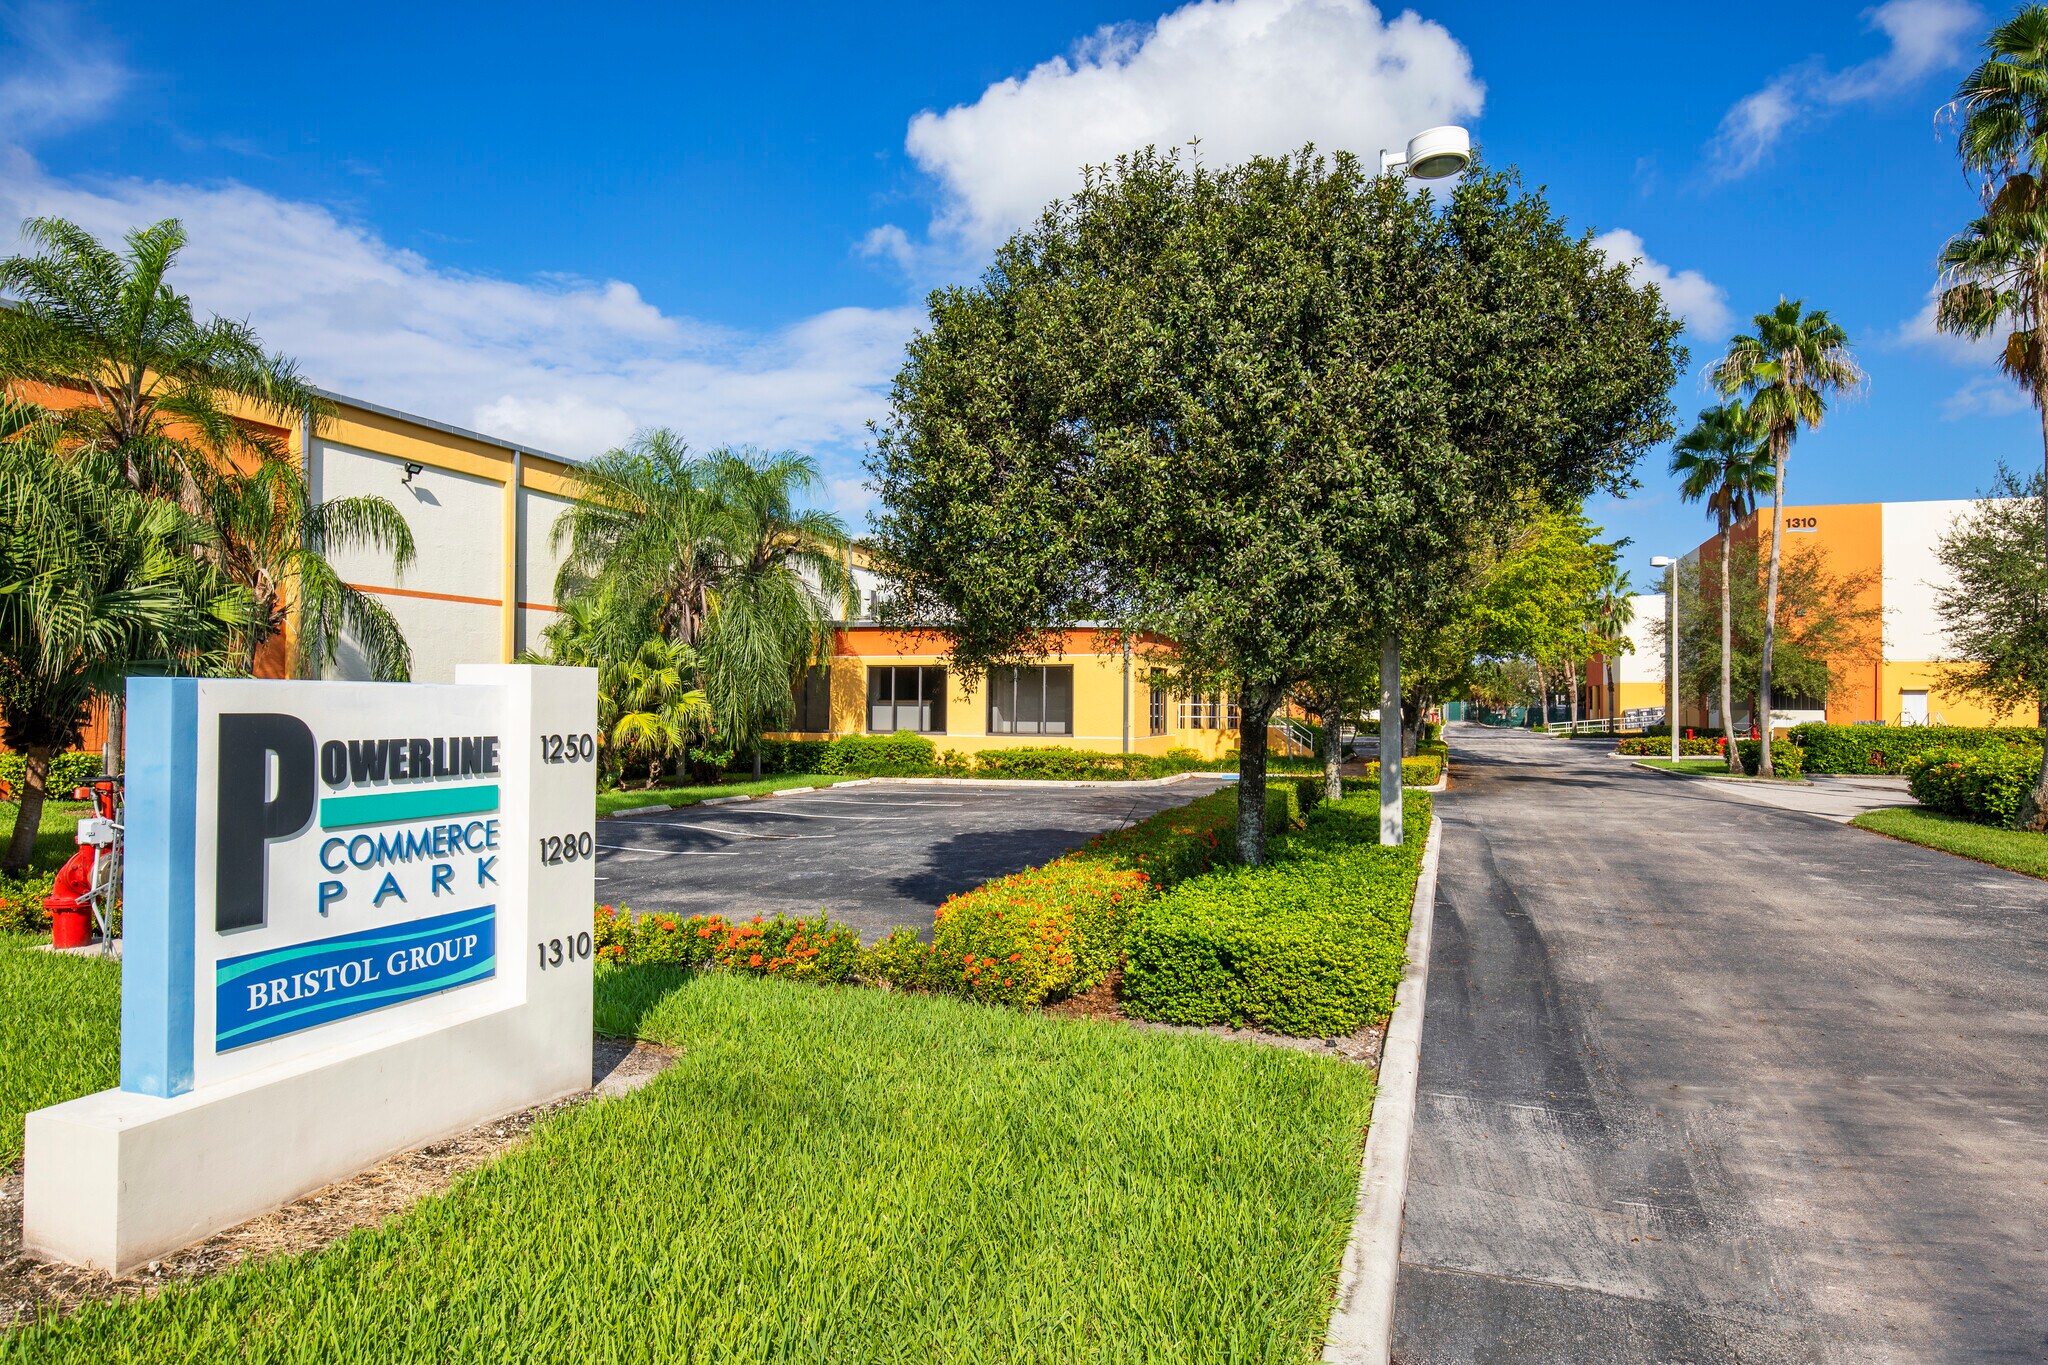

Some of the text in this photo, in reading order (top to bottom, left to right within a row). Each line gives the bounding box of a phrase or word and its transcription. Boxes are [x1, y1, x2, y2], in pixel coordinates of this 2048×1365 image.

[1785, 517, 1817, 528] 1310
[540, 733, 593, 765] 1250
[215, 712, 499, 932] POWERLINE
[319, 819, 499, 872] COMMERCE
[539, 831, 592, 866] 1280
[318, 855, 497, 914] PARK
[246, 934, 478, 1012] BRISTOL GROUP
[537, 931, 591, 970] 1310
